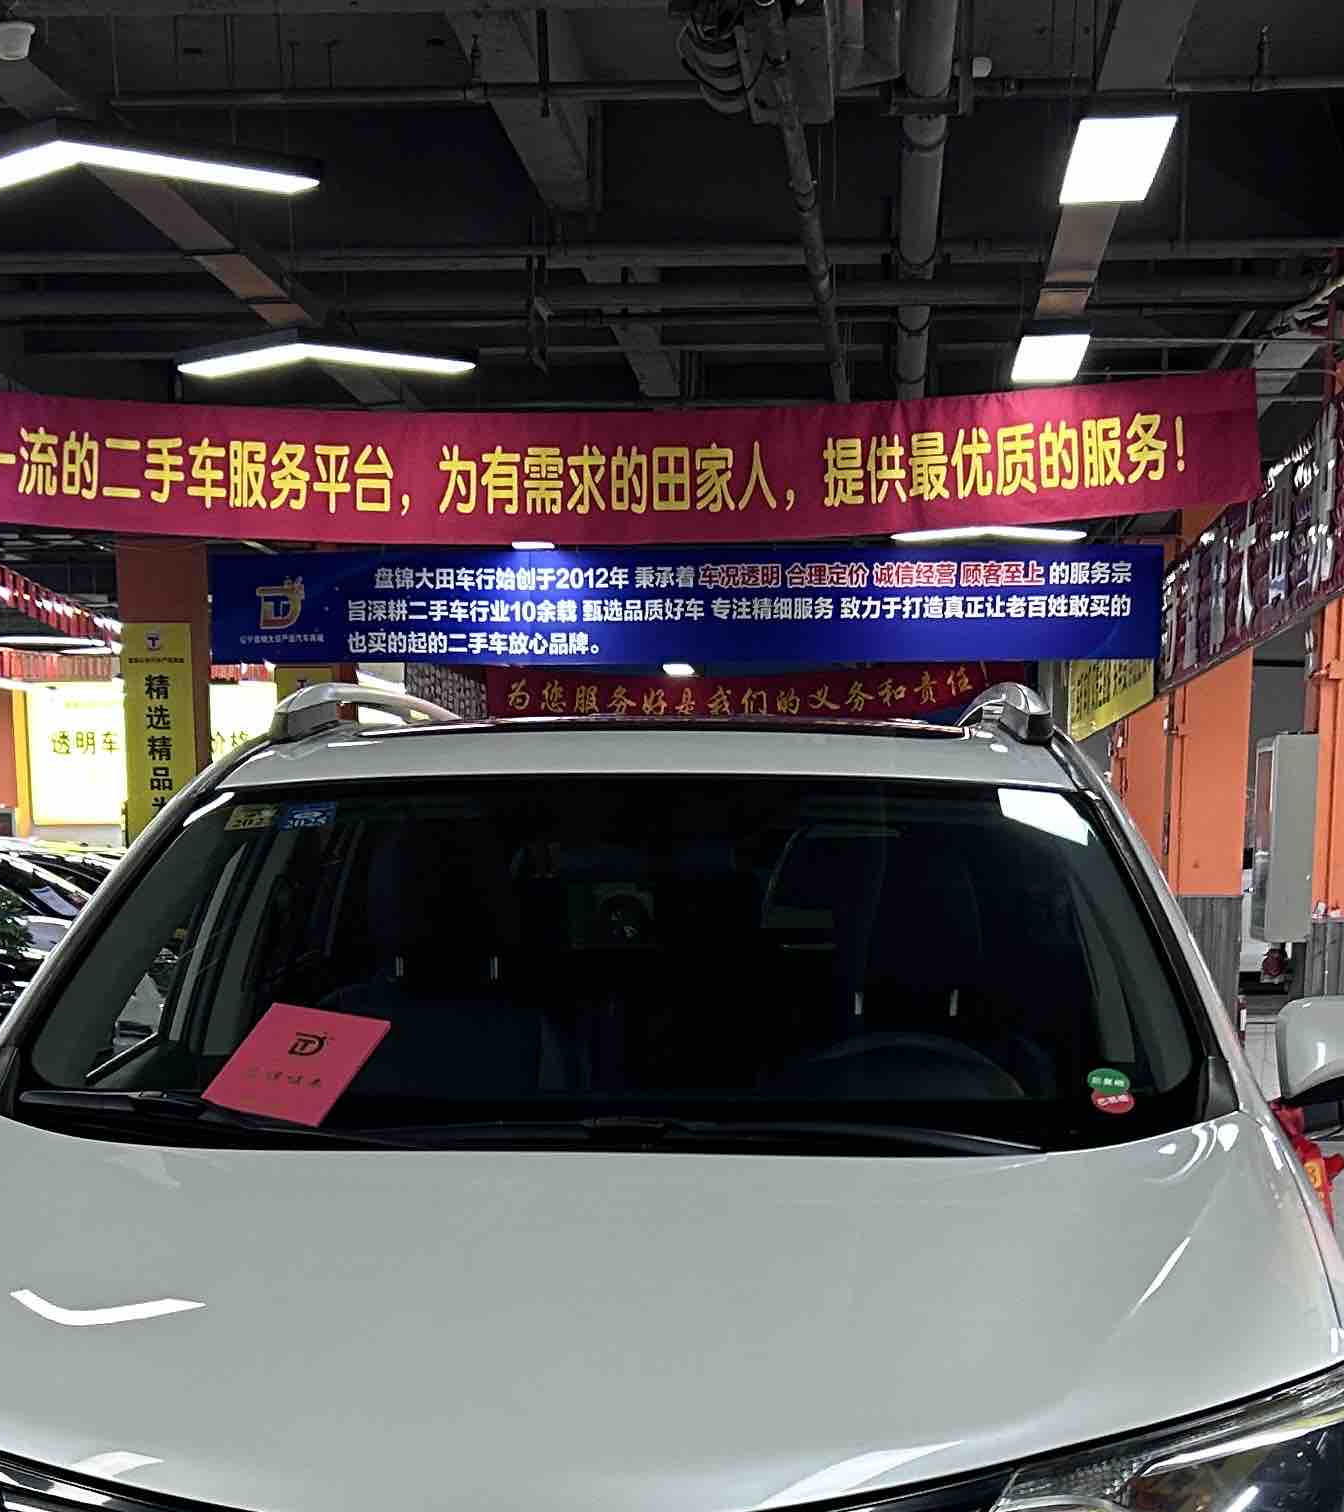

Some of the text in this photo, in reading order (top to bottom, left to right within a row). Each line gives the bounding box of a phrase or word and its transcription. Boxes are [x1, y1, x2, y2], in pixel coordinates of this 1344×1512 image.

[374, 561, 1133, 592] 盘锦大田车行始创于2012年 秉承着 车况透明 合理定价 诚信经营 顾客至上 的服务宗
[348, 594, 1131, 623] 旨深耕二手车行业10余载 甄选品质好车 专注精细服务 致力于打造真正让老百姓敢买的
[347, 632, 601, 656] 也买的起的二手车放心品牌。
